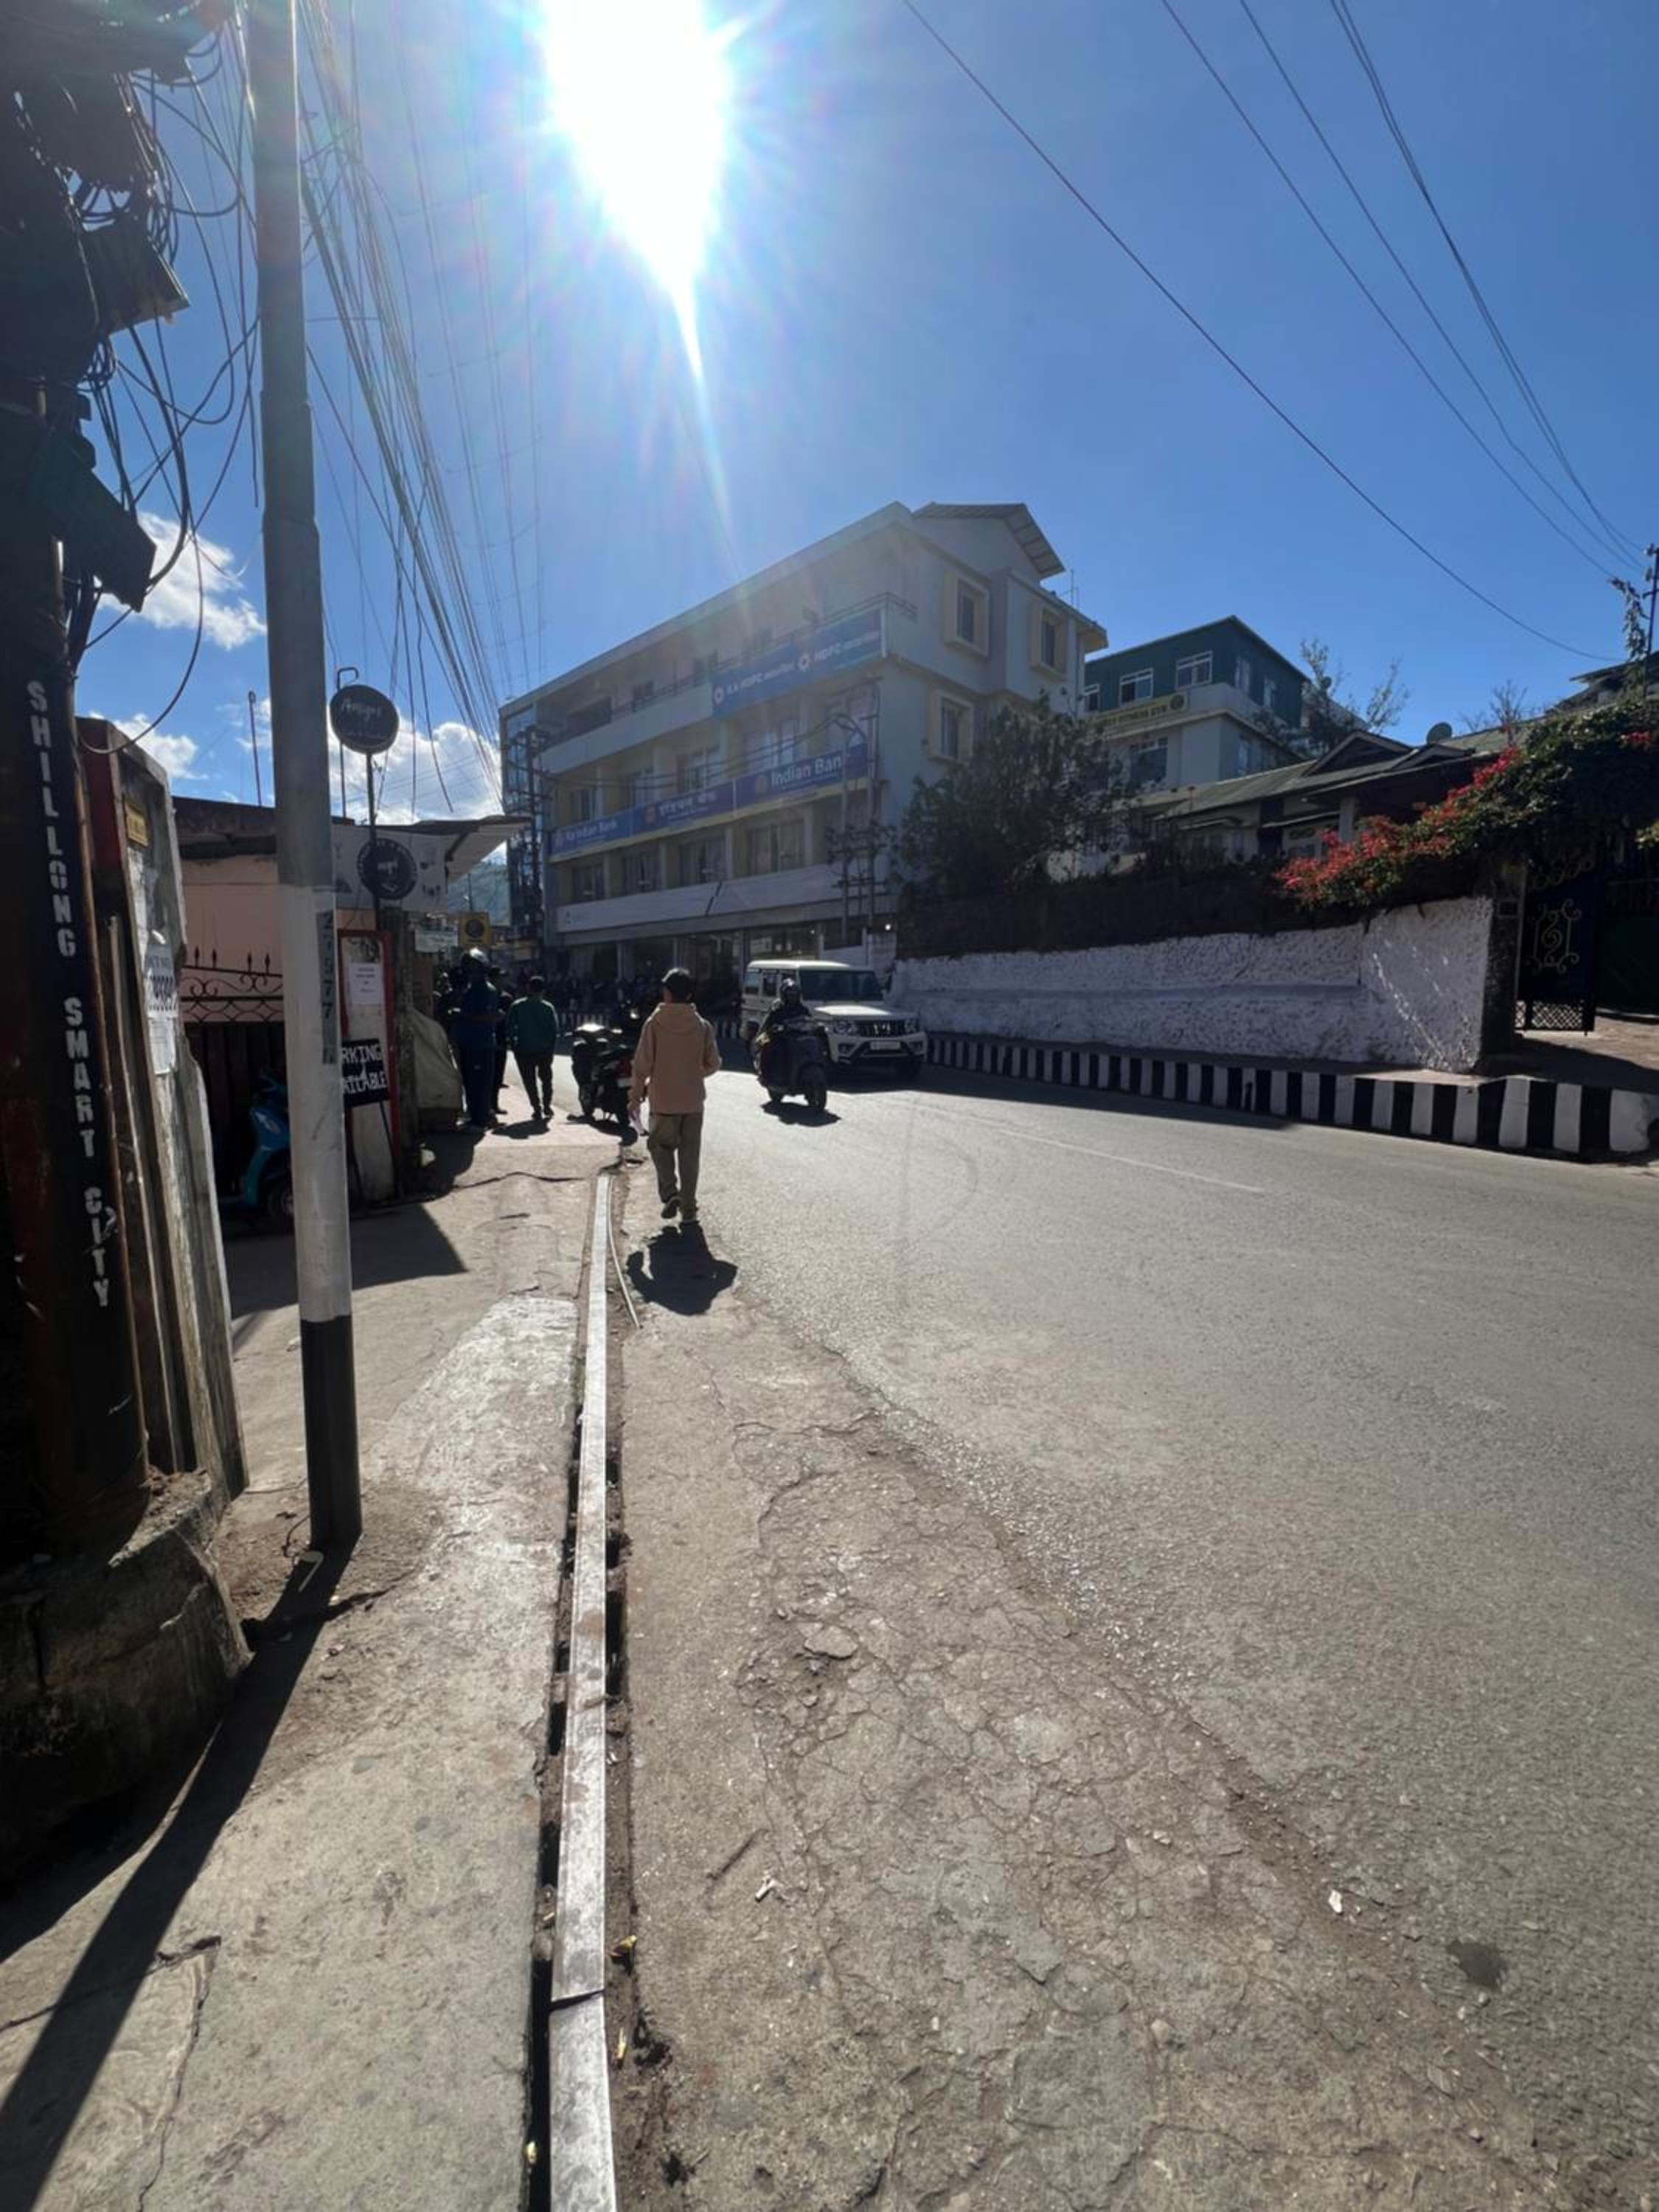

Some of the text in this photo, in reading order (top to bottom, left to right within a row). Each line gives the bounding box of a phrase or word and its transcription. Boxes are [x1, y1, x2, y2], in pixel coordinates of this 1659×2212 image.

[771, 764, 812, 786] Indian
[815, 756, 844, 776] Ban
[27, 681, 110, 1308] SHILLONG SMART CITY
[341, 1044, 382, 1063] RKING
[342, 1070, 387, 1093] AILABLE
